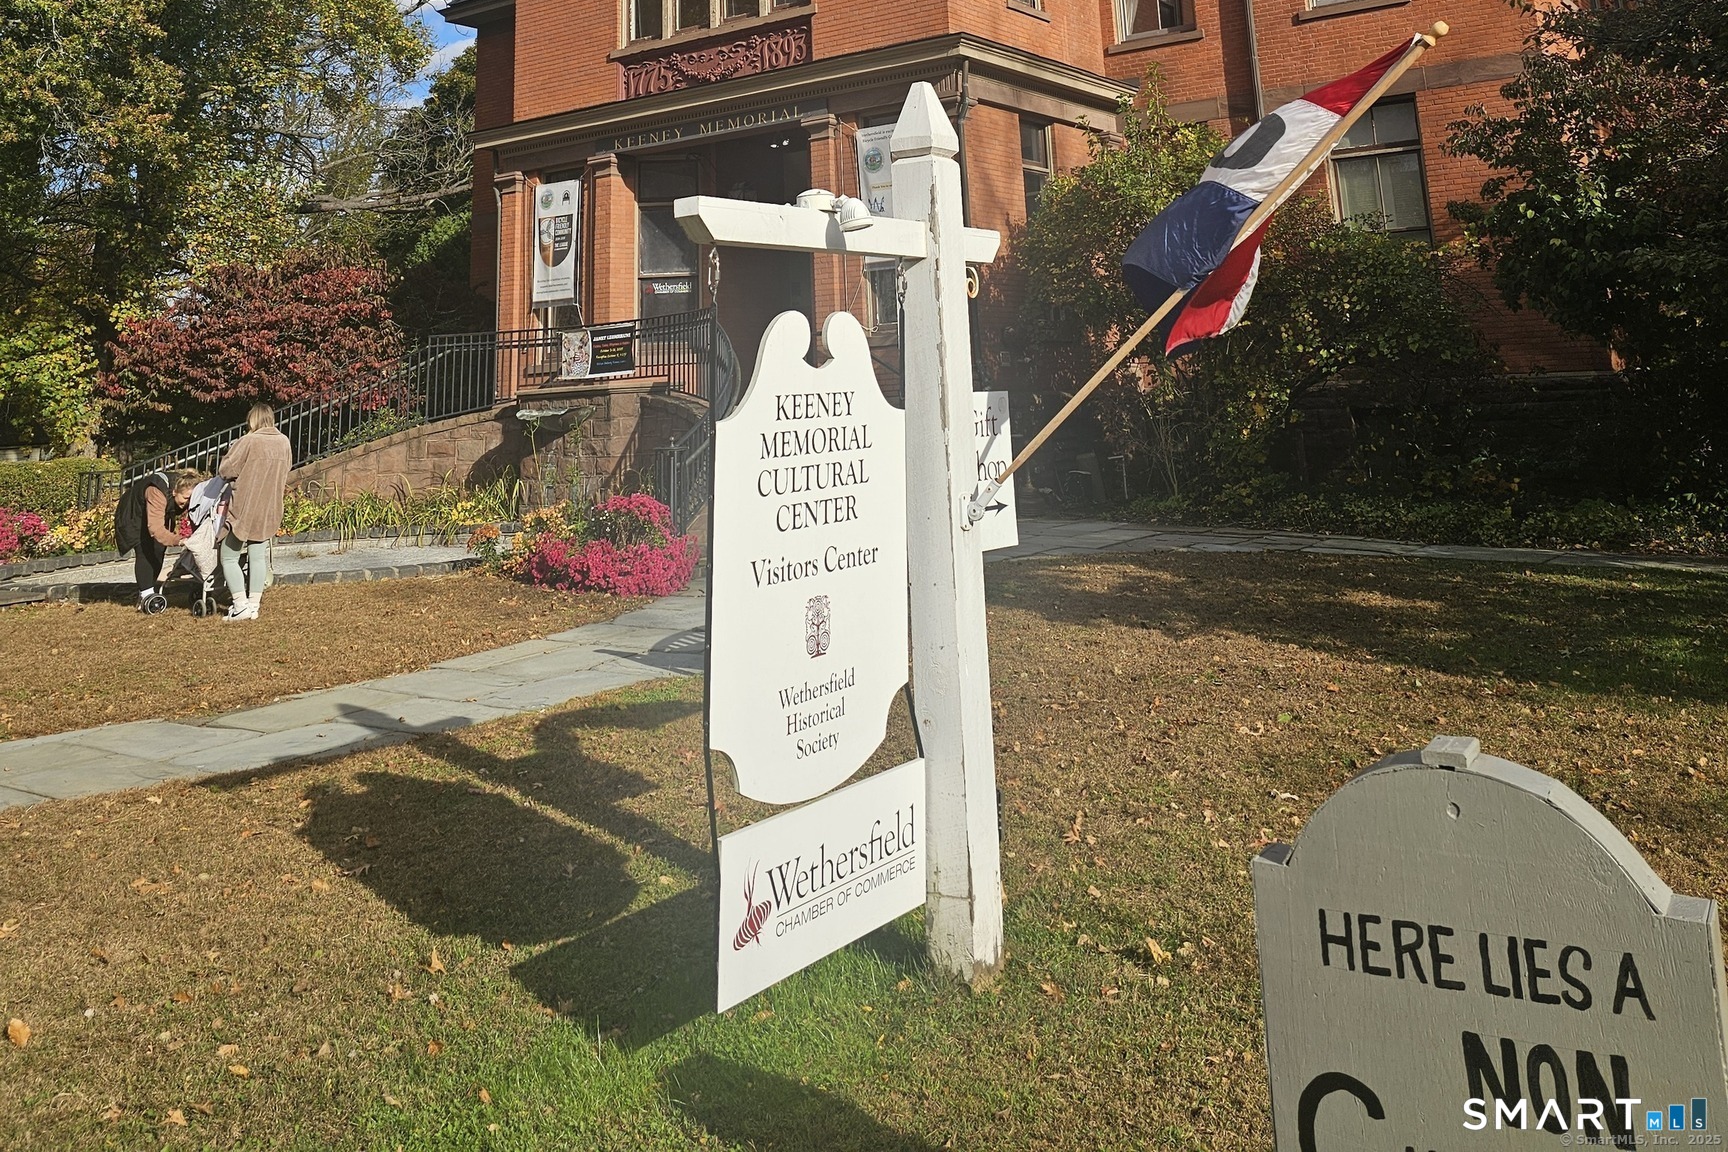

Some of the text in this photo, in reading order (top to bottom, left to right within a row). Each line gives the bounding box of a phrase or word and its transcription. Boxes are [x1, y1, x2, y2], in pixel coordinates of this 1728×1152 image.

[626, 26, 807, 98] 1775 1893
[614, 106, 804, 150] KEENEY MEMORIAL
[775, 391, 855, 421] KEENEY
[974, 407, 999, 437] ift
[760, 424, 873, 460] MEMORIAL
[757, 458, 870, 498] CULTURAL
[776, 495, 858, 533] CENTER
[750, 545, 879, 588] Visitors Center
[778, 667, 856, 710] Wethersfield
[785, 697, 846, 737] Historical
[796, 729, 840, 760] Society
[765, 803, 916, 911] Wethersfield
[775, 857, 916, 938] CHAMBER OF COMMERCE
[1318, 908, 1657, 1021] HERE LIES A
[1461, 1030, 1637, 1151] NON
